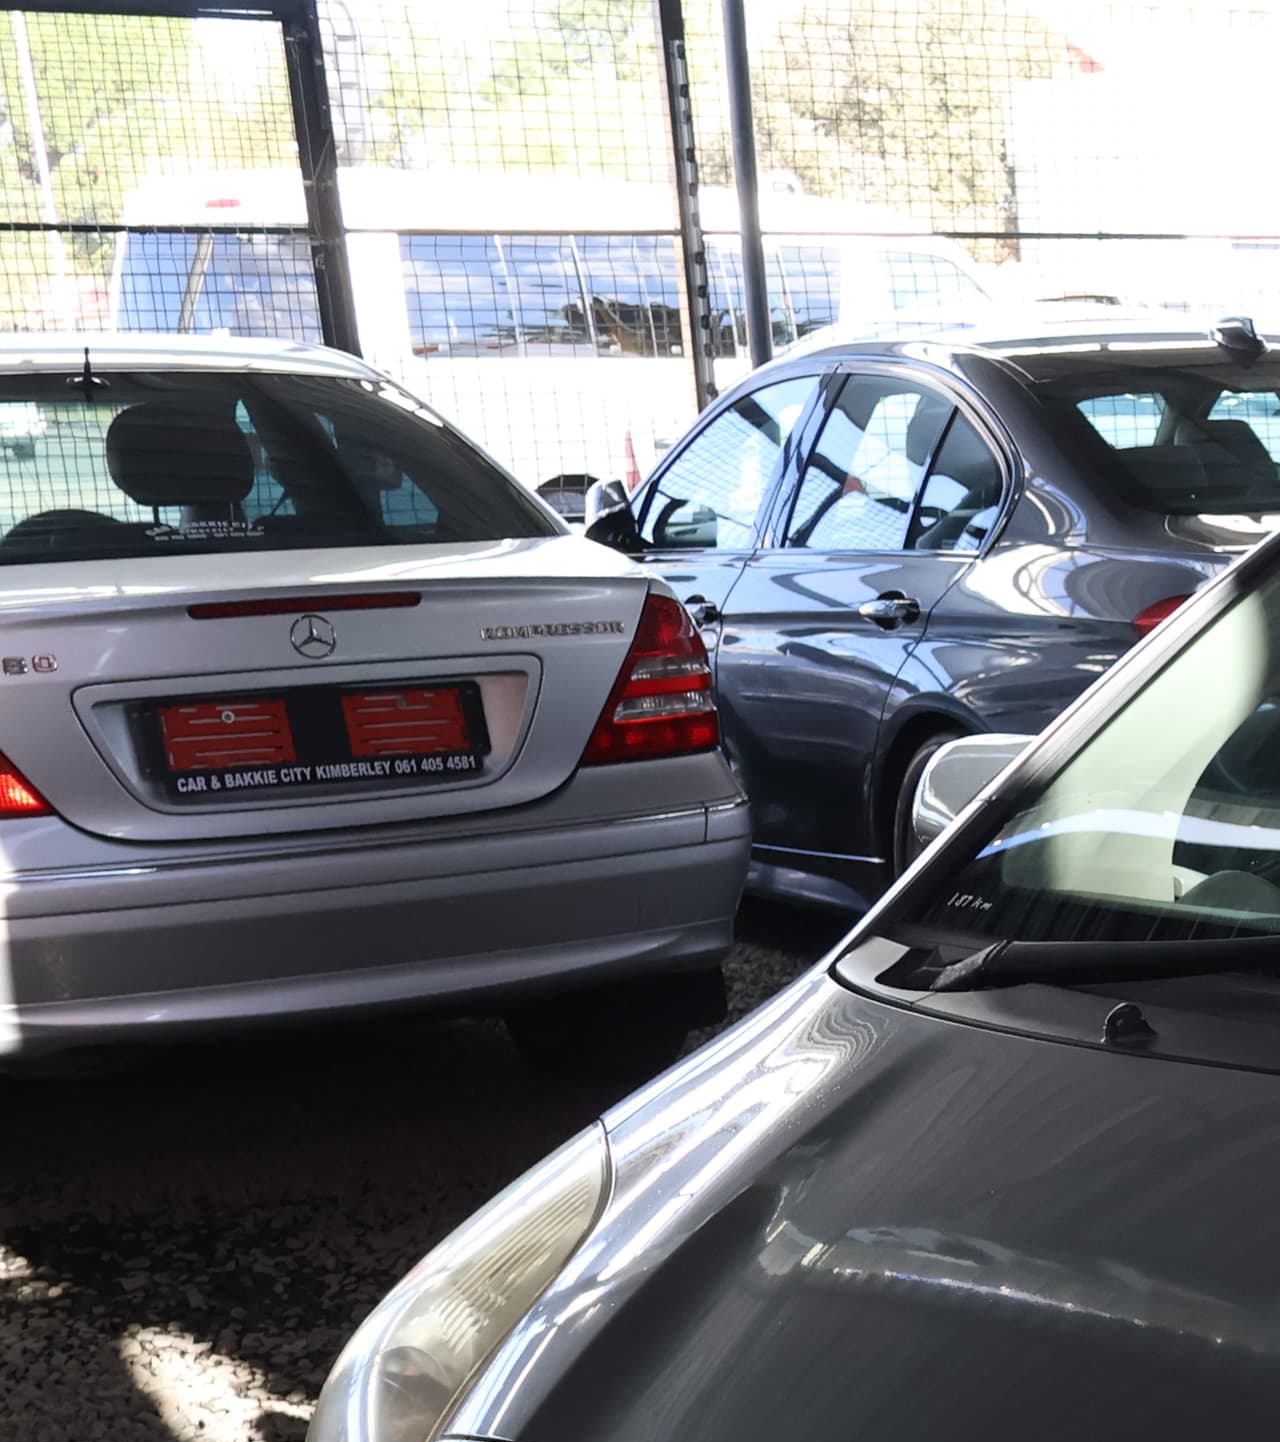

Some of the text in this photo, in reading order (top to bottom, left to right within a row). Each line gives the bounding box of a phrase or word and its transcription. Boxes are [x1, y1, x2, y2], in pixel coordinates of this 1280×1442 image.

[177, 755, 477, 793] CAR & BAKKIE CITY KIMBERLEY 061 405 4581
